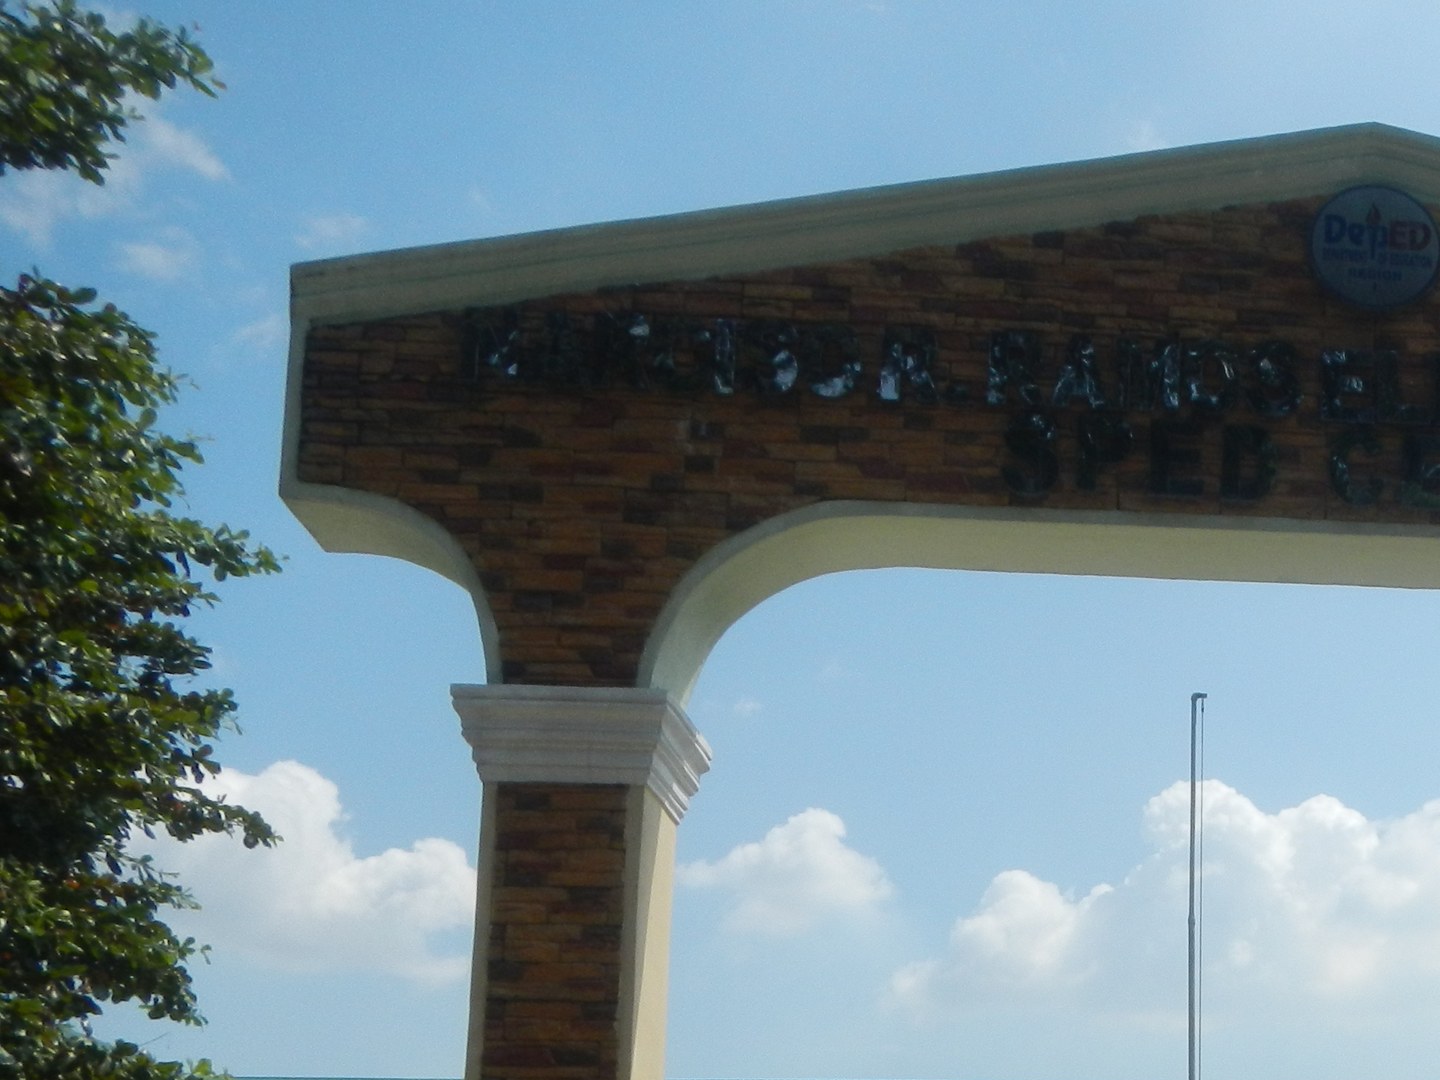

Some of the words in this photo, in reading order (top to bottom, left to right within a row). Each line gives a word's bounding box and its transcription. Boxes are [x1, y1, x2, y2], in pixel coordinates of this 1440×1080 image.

[1324, 212, 1431, 260] DepED
[984, 331, 1304, 418] RAMOS
[999, 411, 1280, 502] SPED
